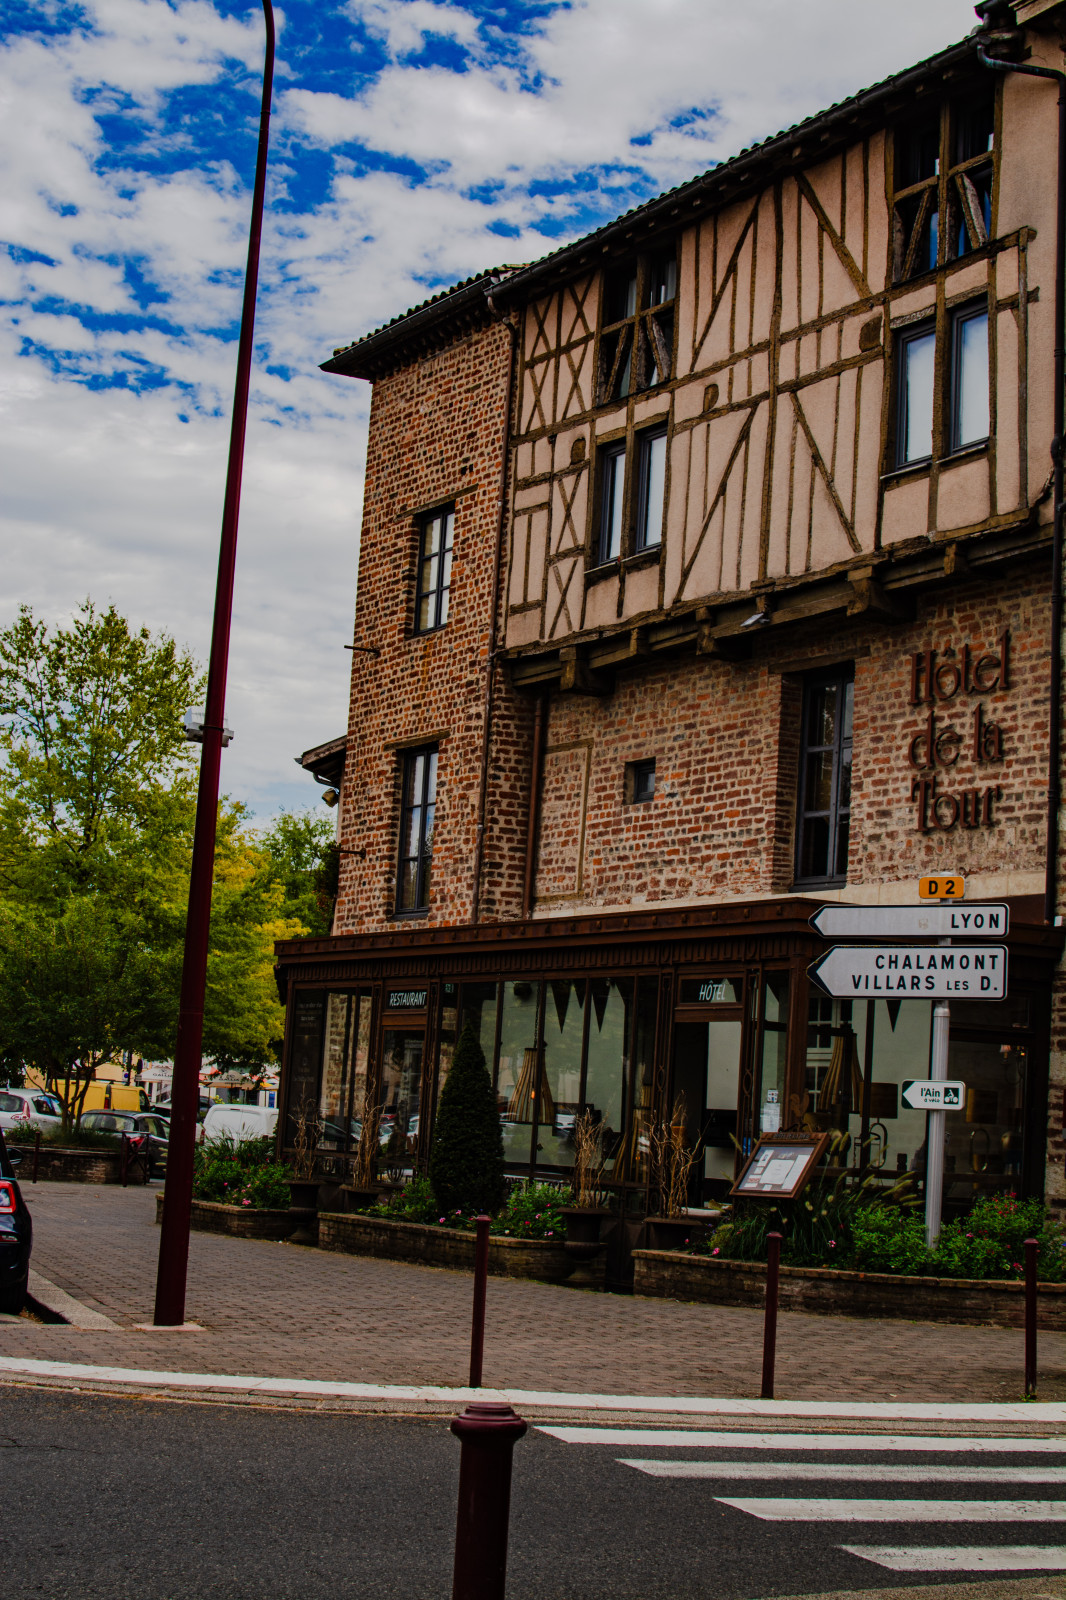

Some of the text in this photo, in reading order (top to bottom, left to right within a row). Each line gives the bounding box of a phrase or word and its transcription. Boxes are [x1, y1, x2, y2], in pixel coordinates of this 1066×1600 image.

[908, 628, 1010, 705] Hôtel
[908, 703, 1003, 770] de la
[911, 775, 1003, 833] Tour
[929, 880, 955, 894] D 2
[951, 914, 999, 928] LYON
[876, 955, 998, 969] CHALAMONT
[698, 980, 726, 1001] HÔTEL
[852, 974, 998, 991] VILLARS LES D.
[389, 991, 427, 1007] RESTAURANT
[921, 1087, 940, 1097] l'Ain
